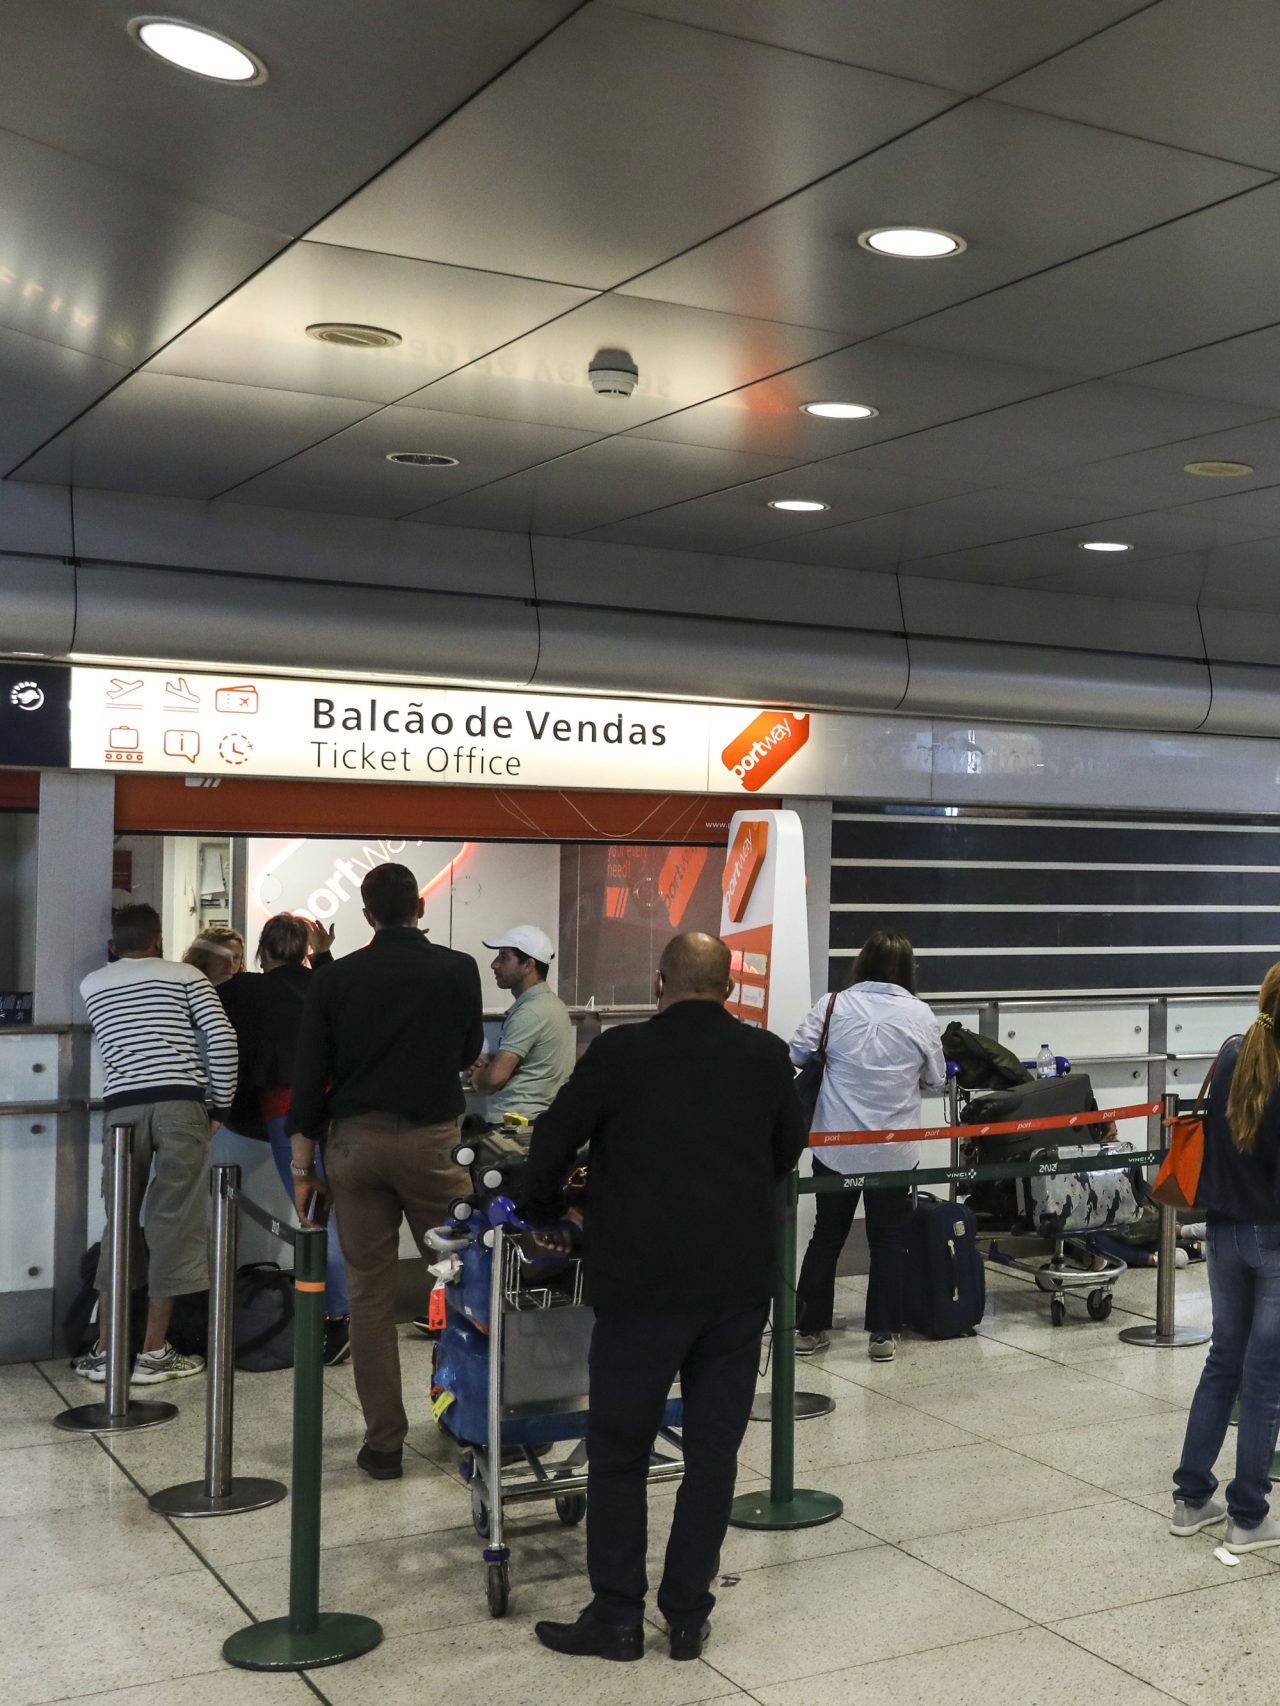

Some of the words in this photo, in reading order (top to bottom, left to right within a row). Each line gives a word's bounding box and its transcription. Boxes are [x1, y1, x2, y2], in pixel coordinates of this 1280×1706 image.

[313, 697, 454, 735] Balcão
[465, 705, 513, 738] de
[525, 709, 667, 747] Vendas
[310, 740, 412, 772] Ticket
[426, 746, 522, 776] Office
[729, 717, 793, 785] portway
